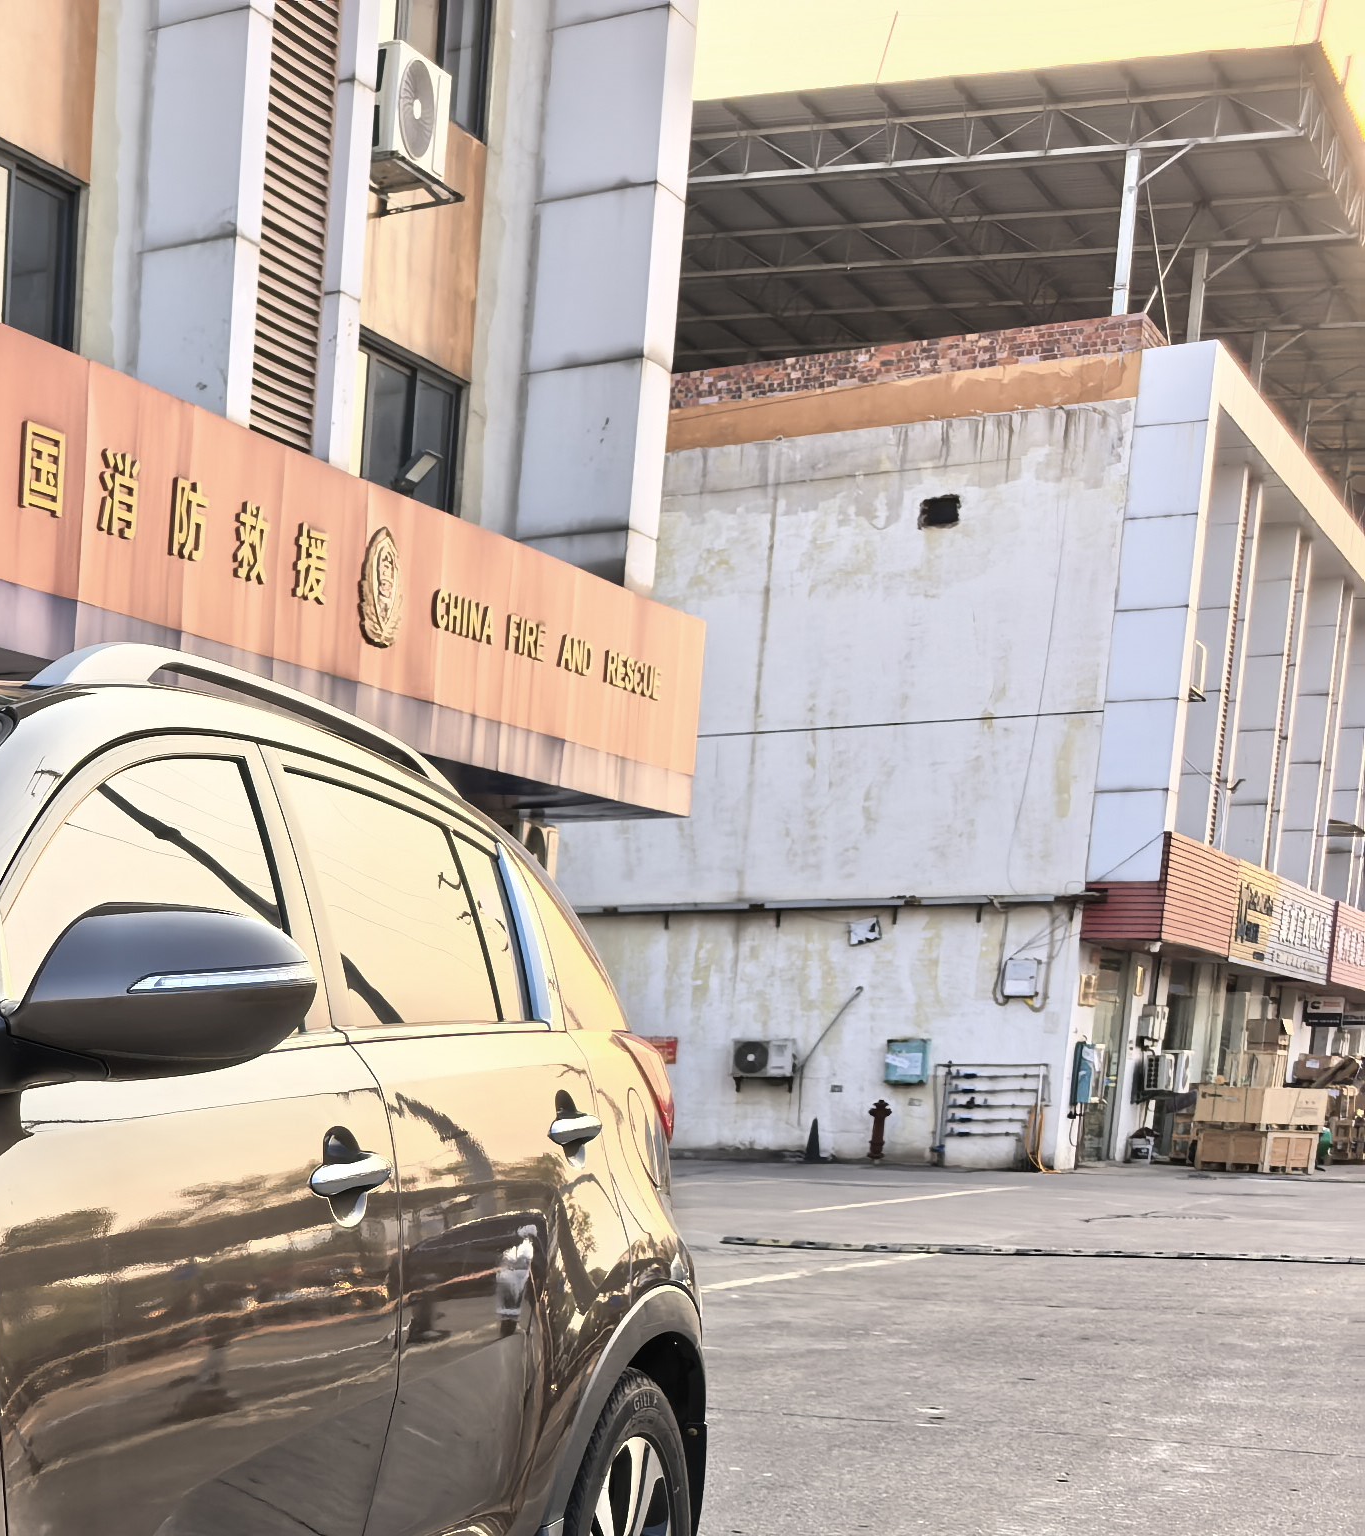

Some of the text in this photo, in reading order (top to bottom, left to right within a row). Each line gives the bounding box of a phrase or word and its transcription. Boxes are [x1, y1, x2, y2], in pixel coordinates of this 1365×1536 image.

[432, 588, 662, 701] CHINA FIRE AND RESCUE
